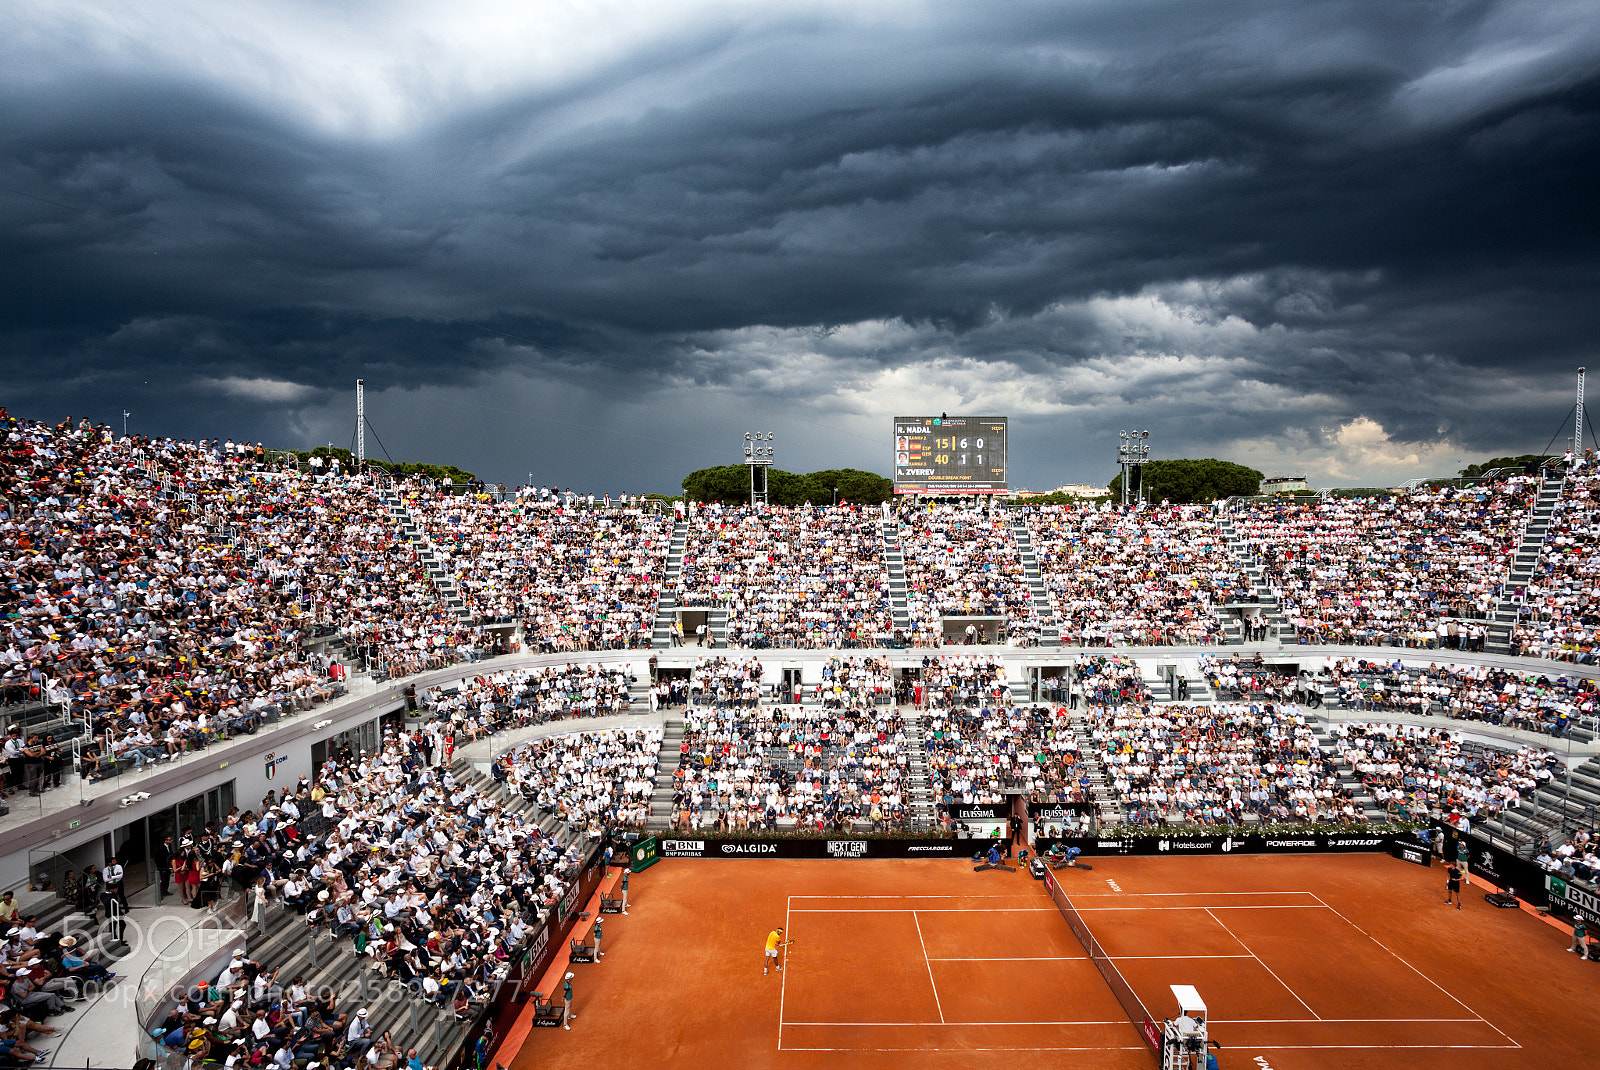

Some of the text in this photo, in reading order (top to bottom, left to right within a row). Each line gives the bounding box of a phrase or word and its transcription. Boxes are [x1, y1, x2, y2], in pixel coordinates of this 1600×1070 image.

[897, 426, 932, 434] R. NADAL
[935, 438, 984, 449] 15 6 0
[935, 454, 983, 465] 40 1 1
[897, 468, 935, 476] A. ZVEREV
[276, 755, 288, 765] CONI
[959, 809, 995, 818] LEVISSIMA
[677, 841, 703, 851] BNL
[735, 844, 776, 853] ALGIDA
[828, 842, 866, 852] NEXT GEN
[1172, 841, 1211, 849] Hotels.com
[1473, 862, 1500, 878] PEUGEOT
[1548, 894, 1567, 907] BNP
